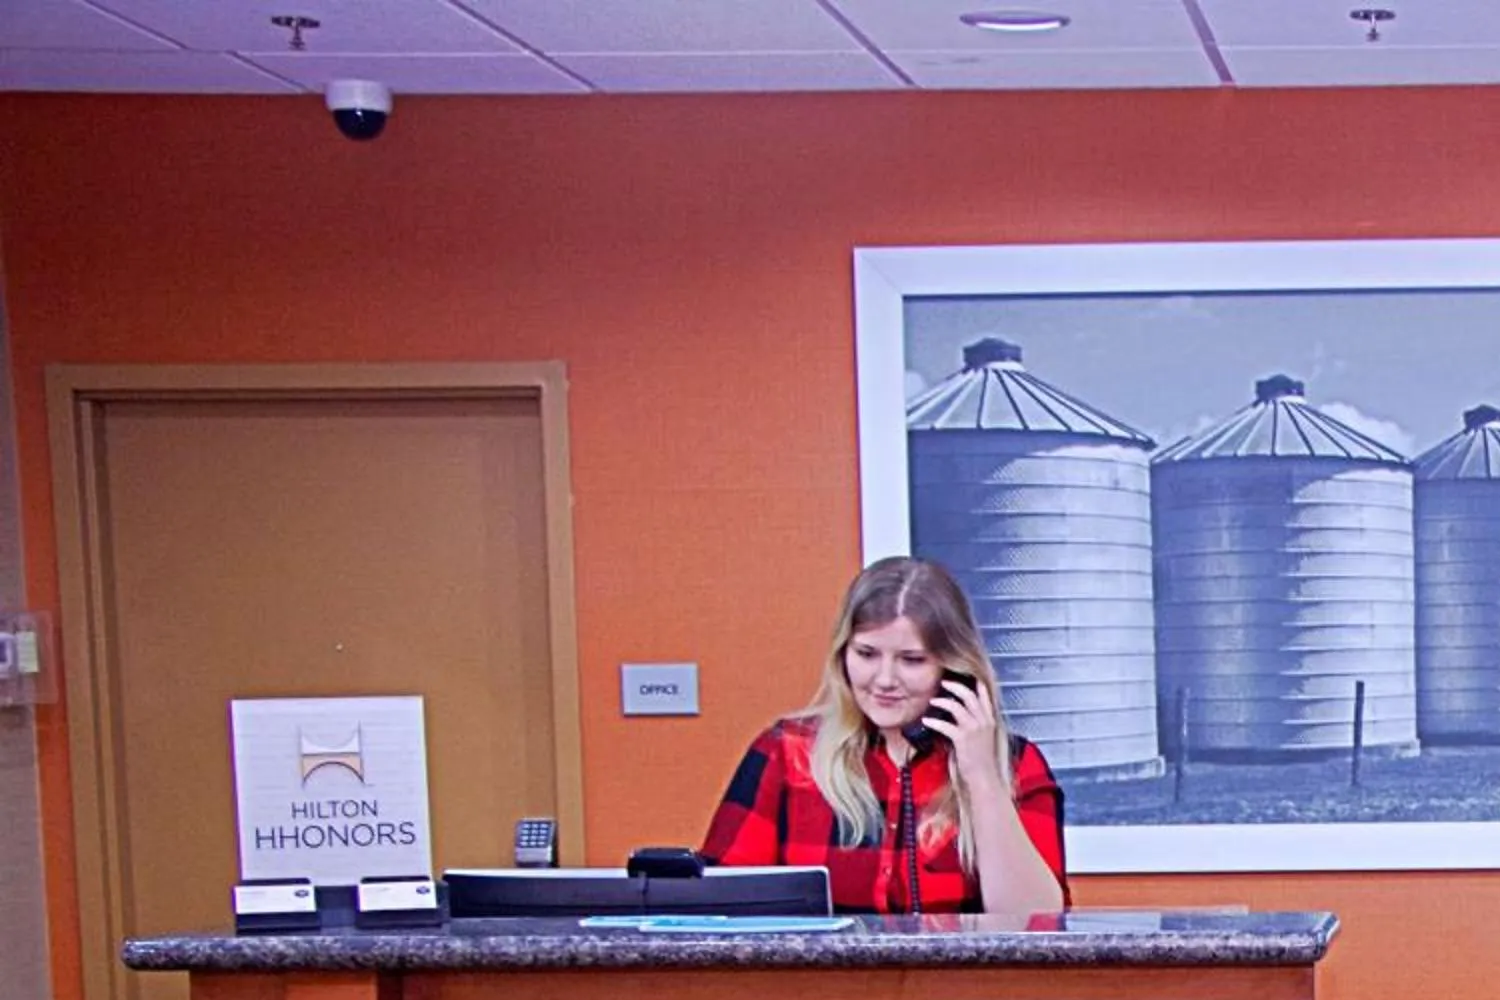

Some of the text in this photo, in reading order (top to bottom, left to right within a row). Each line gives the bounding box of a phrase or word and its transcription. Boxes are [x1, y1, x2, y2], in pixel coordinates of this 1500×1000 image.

[640, 684, 678, 696] OFFICE
[291, 800, 378, 819] HILTON
[255, 821, 417, 849] HHONORS
